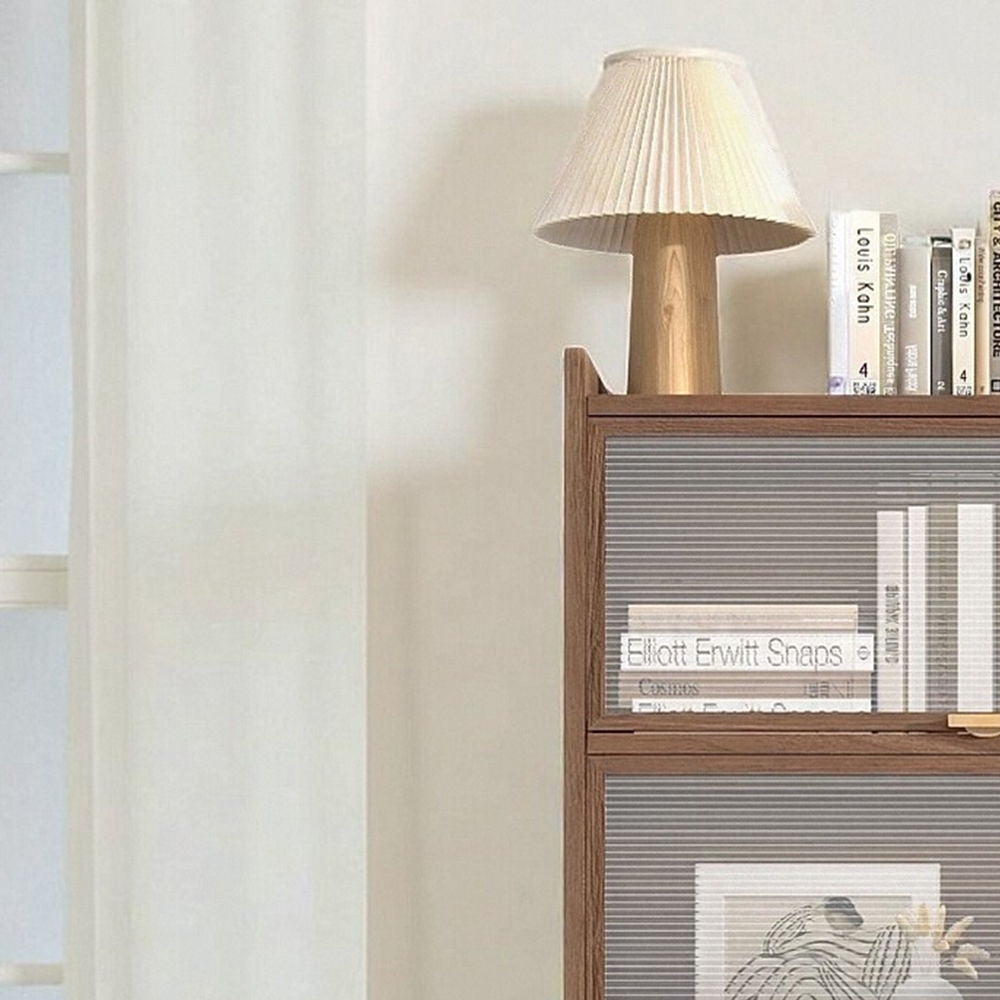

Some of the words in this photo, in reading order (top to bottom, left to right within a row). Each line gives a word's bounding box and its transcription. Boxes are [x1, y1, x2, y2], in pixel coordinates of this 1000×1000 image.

[857, 228, 874, 272] Louis
[935, 270, 948, 305] Graphic
[959, 257, 971, 294] Louis
[857, 282, 874, 324] Kahn
[937, 306, 948, 315] &
[937, 316, 948, 333] Art
[959, 303, 970, 338] Kahn
[858, 363, 868, 378] 4
[960, 370, 967, 382] 4
[627, 638, 687, 666] Elliott
[696, 638, 759, 666] Erwitt
[767, 637, 843, 671] Snaps
[639, 679, 699, 697] Cosmos
